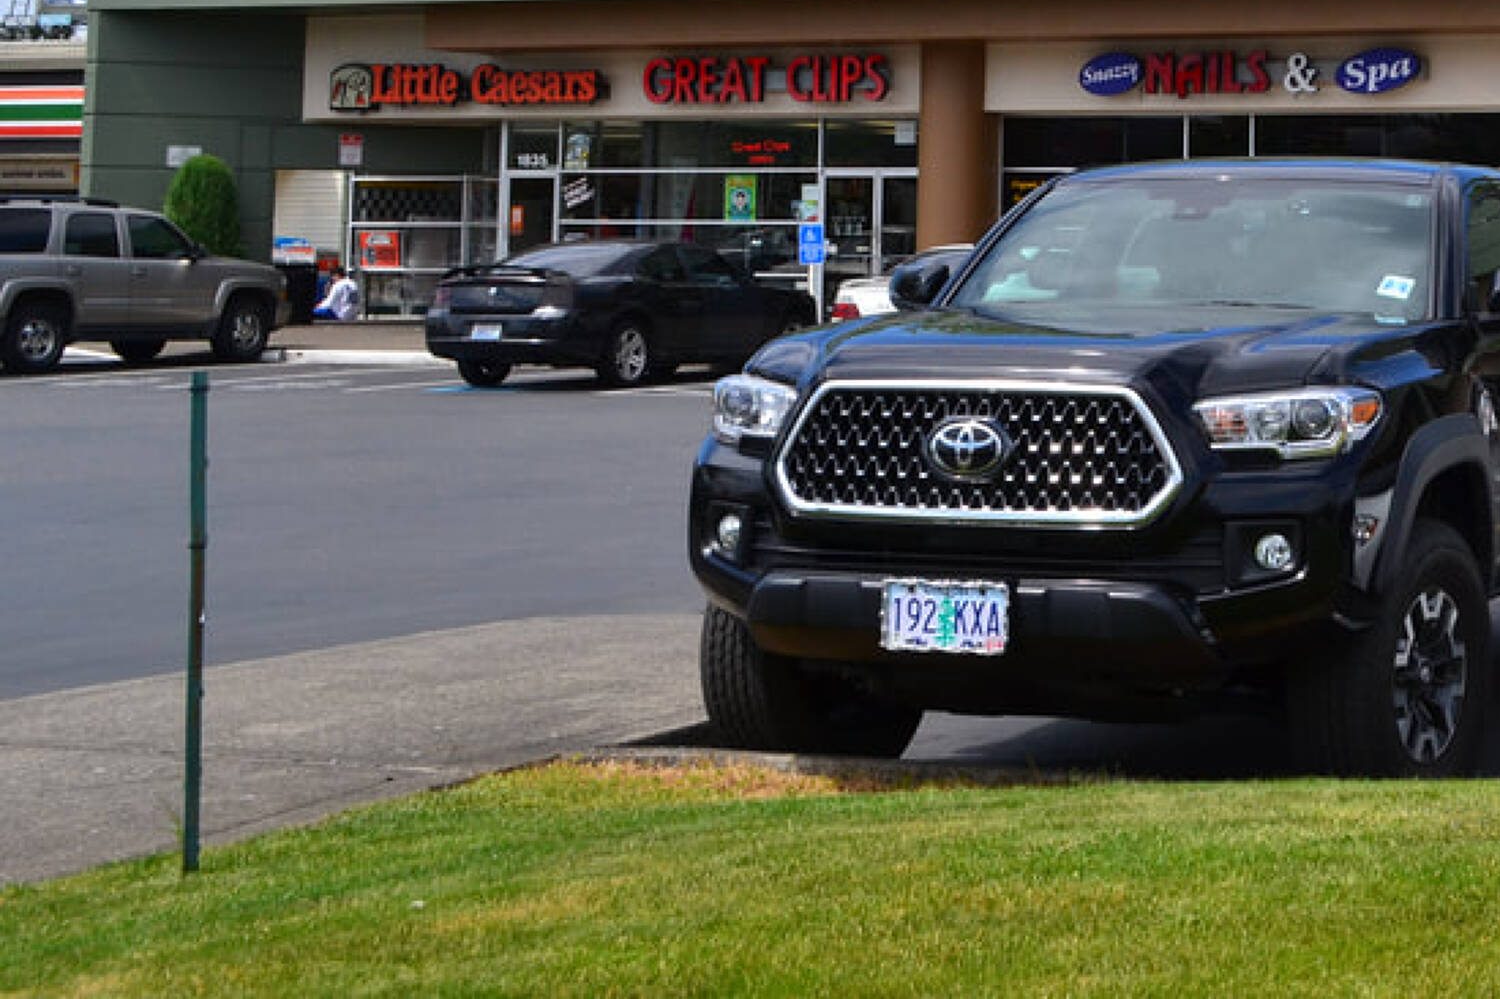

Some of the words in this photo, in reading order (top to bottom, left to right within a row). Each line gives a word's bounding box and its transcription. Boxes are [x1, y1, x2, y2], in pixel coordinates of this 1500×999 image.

[370, 63, 459, 105] Little
[471, 64, 600, 105] Caesars
[643, 56, 769, 105] GREAT
[786, 53, 887, 103] CLIPS
[1082, 61, 1139, 86] Snazzy
[1145, 52, 1271, 98] NAILS
[1284, 52, 1318, 92] &
[1343, 57, 1411, 91] Spa
[894, 597, 938, 634] 192
[954, 600, 1000, 637] KXA
